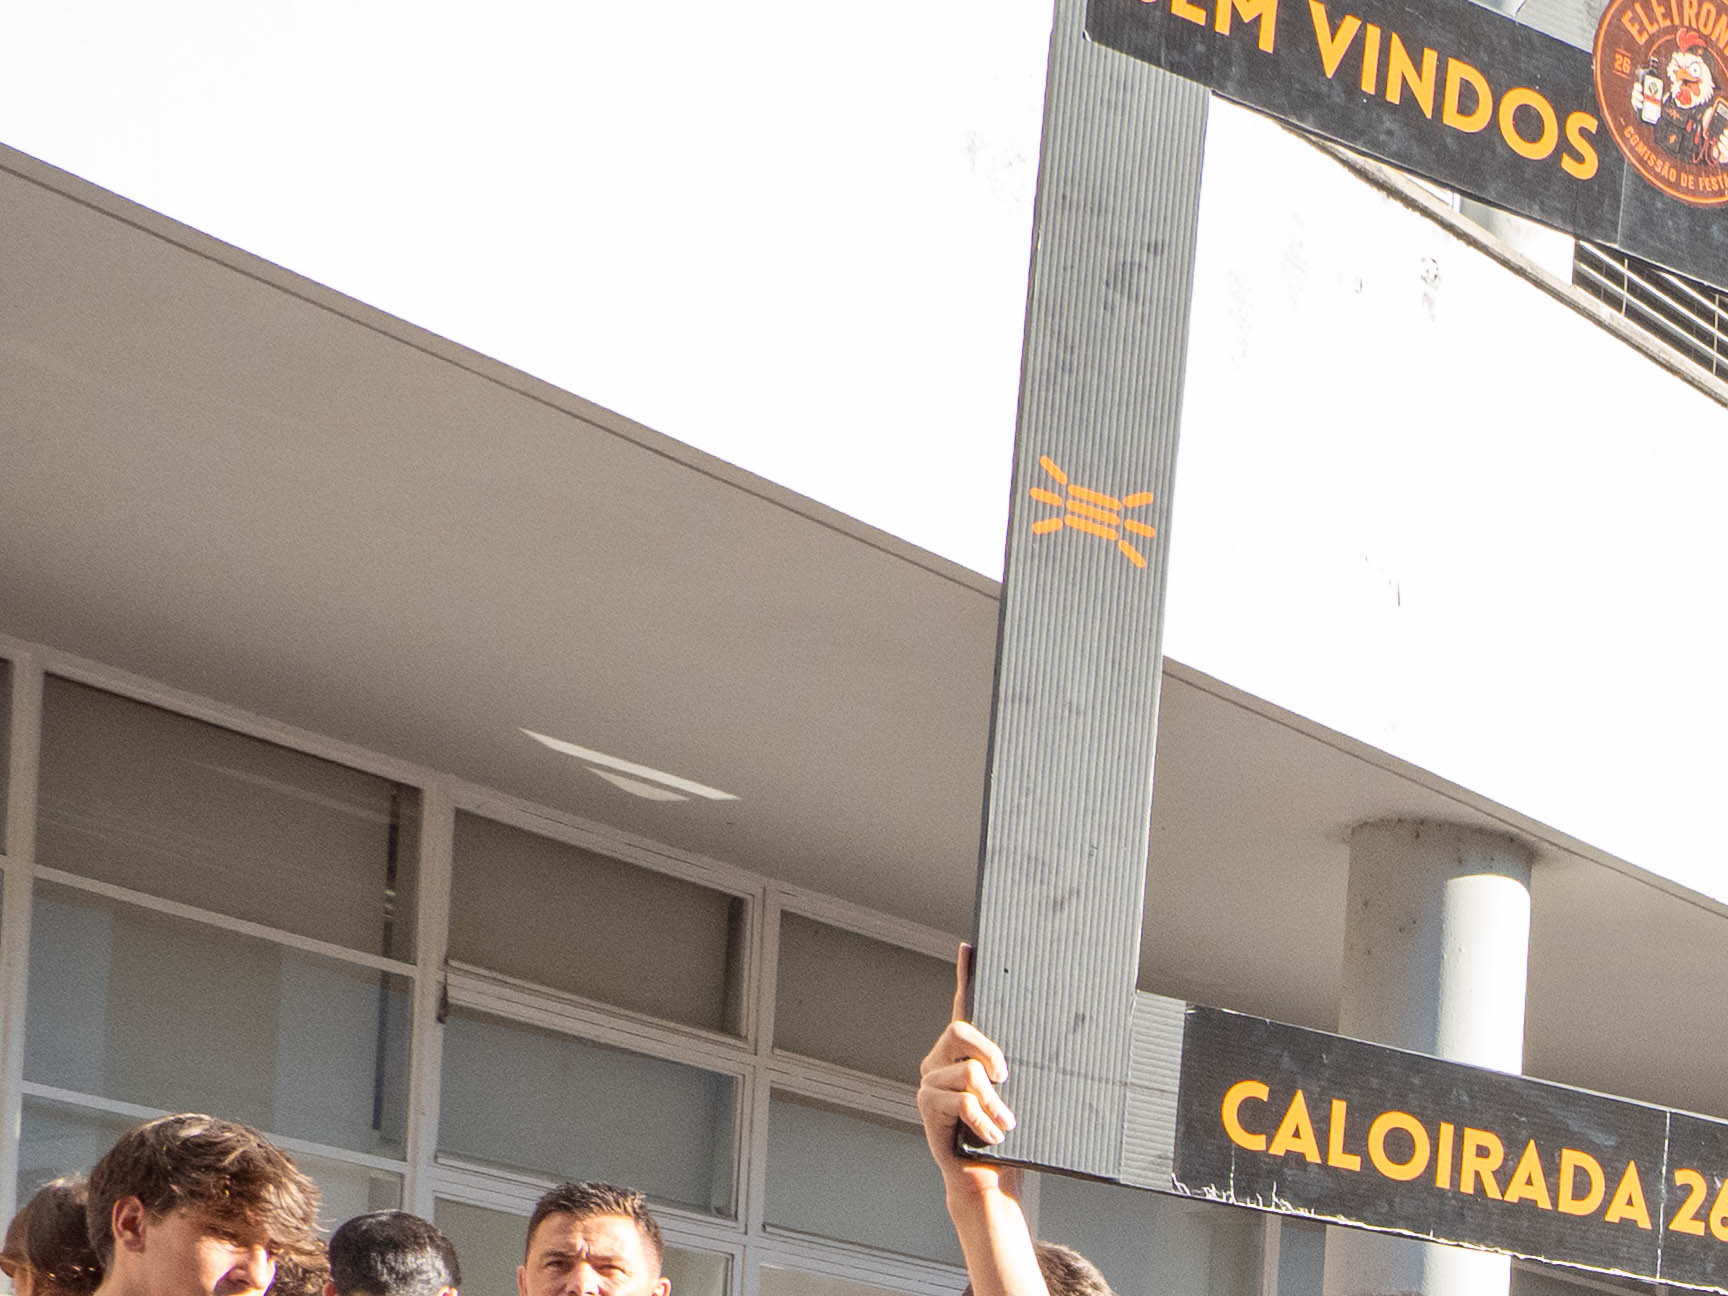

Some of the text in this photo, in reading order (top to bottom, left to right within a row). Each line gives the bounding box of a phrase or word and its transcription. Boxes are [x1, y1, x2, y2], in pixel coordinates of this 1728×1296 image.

[1310, 0, 1600, 180] VINDOS
[1614, 54, 1632, 75] 26
[1623, 124, 1677, 183] COMISSÃO
[1680, 172, 1695, 190] DE
[1221, 1079, 1653, 1231] CALOIRADA
